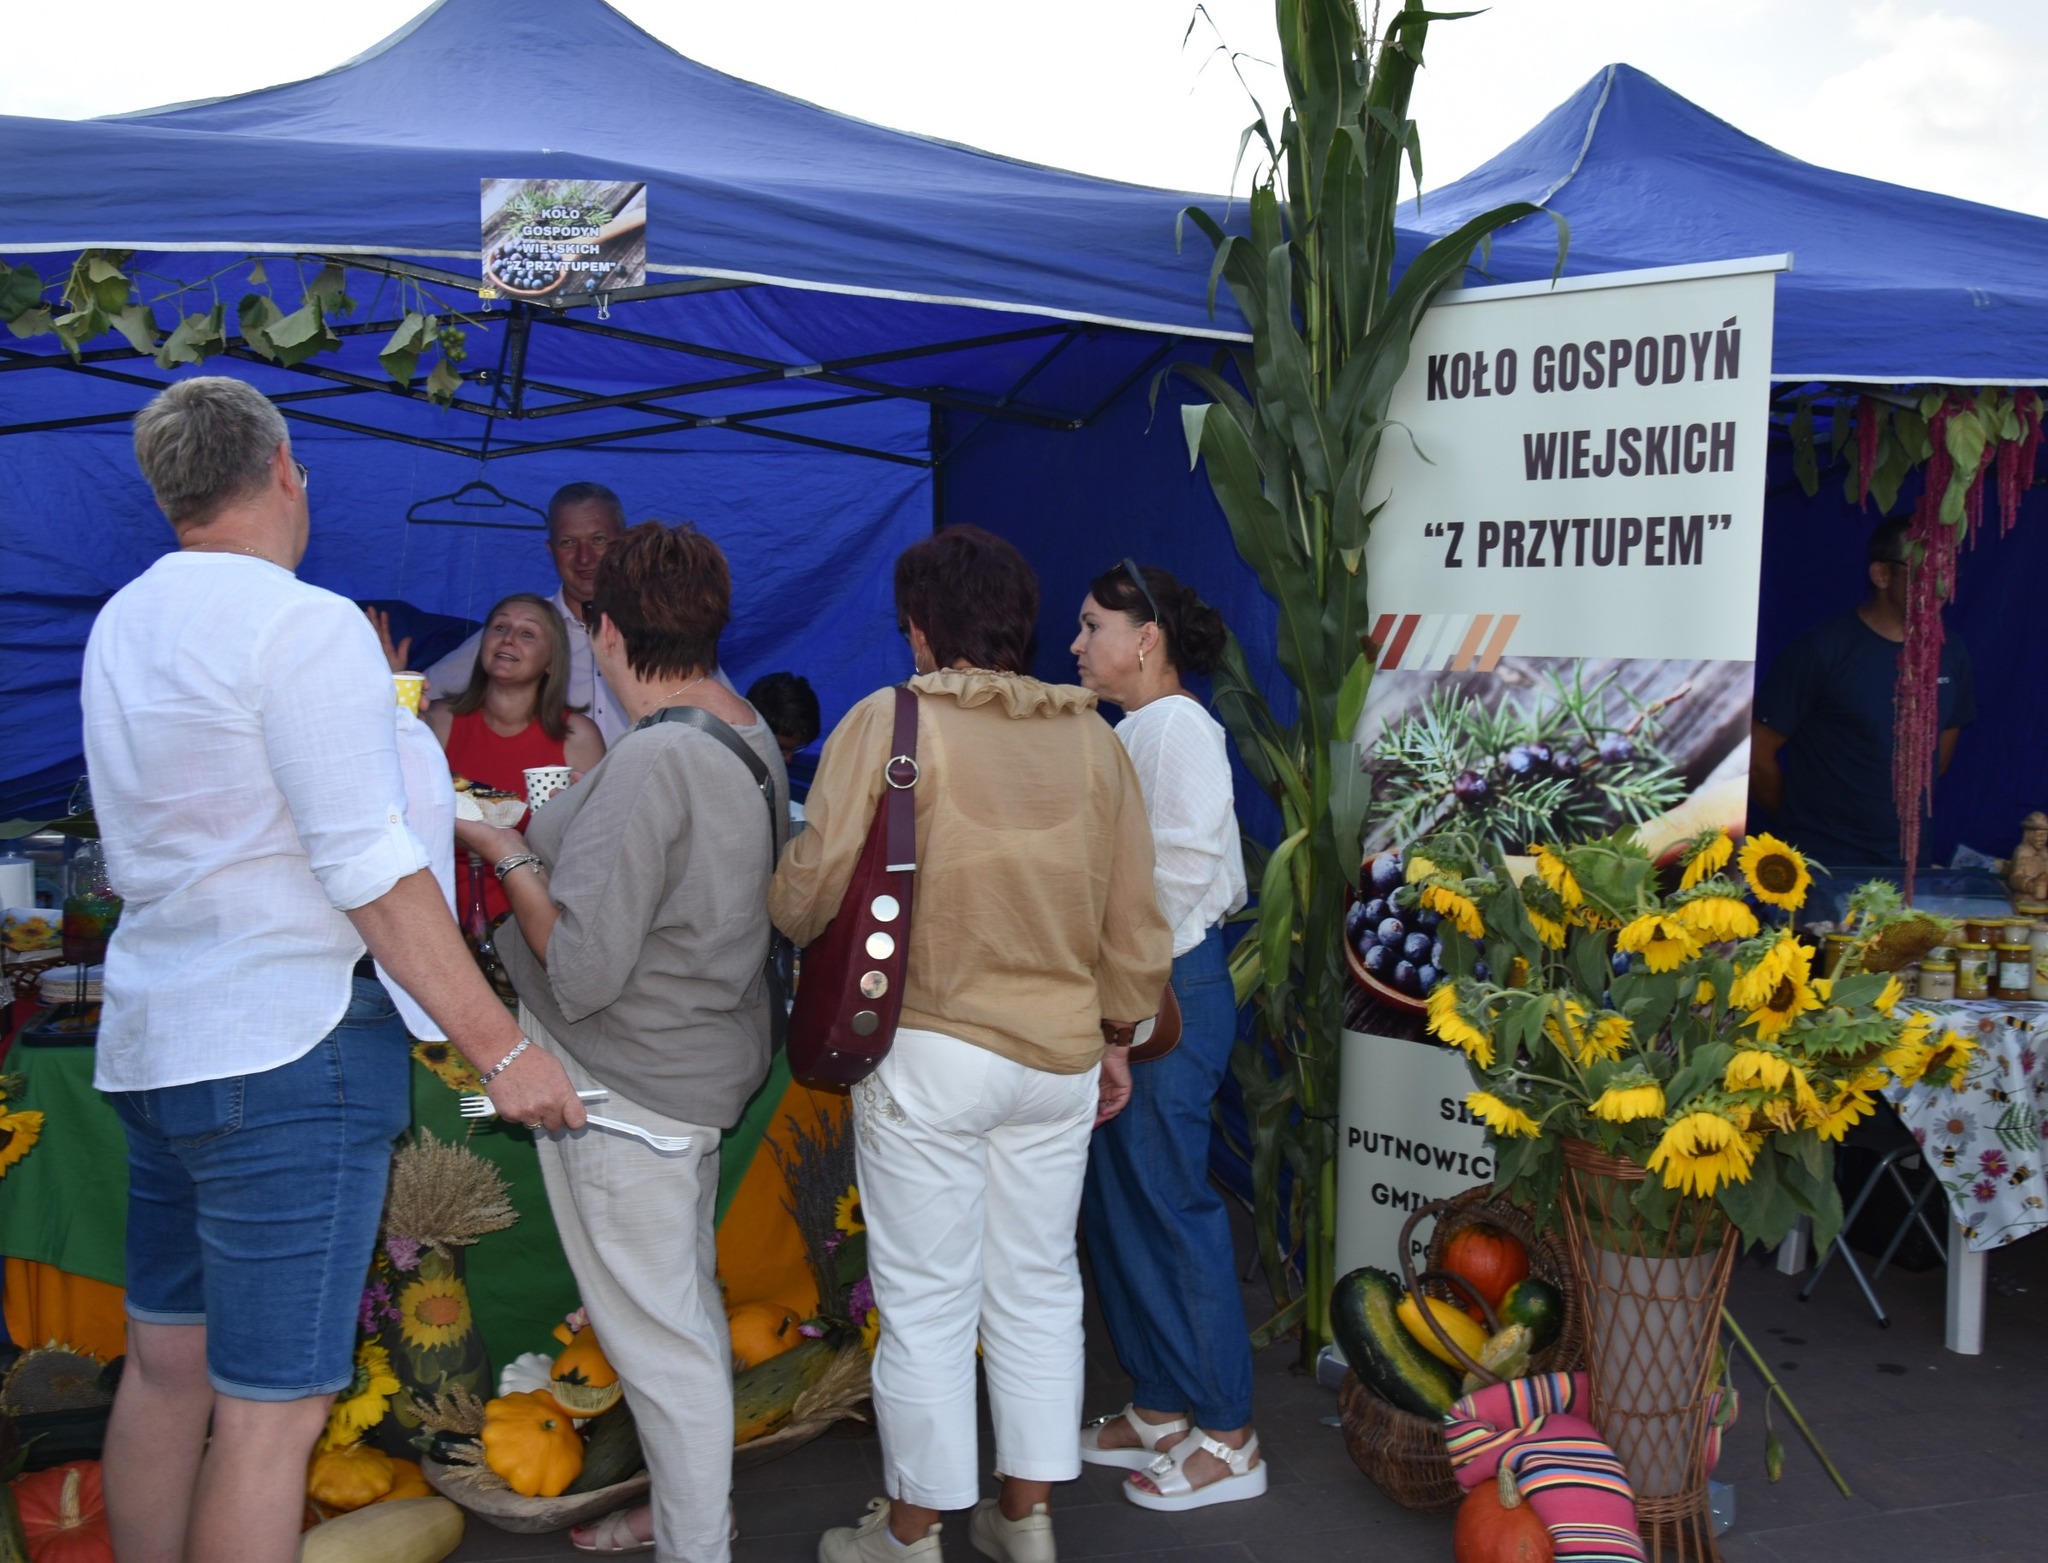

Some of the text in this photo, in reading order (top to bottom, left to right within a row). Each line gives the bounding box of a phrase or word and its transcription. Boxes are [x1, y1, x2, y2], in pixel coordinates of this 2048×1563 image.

[522, 224, 600, 237] GOSPODYŃ
[541, 209, 580, 219] KOŁO
[522, 243, 600, 254] WIEJSKICH
[506, 260, 616, 272] "Z PRZYTUPEM"
[1427, 315, 1741, 401] KOŁO GOSPODYŃ
[1523, 421, 1736, 480] WIEJSKICH
[1477, 514, 1732, 567] PRZYTUPEM”
[1348, 1127, 1499, 1180] PUTNOWIC
